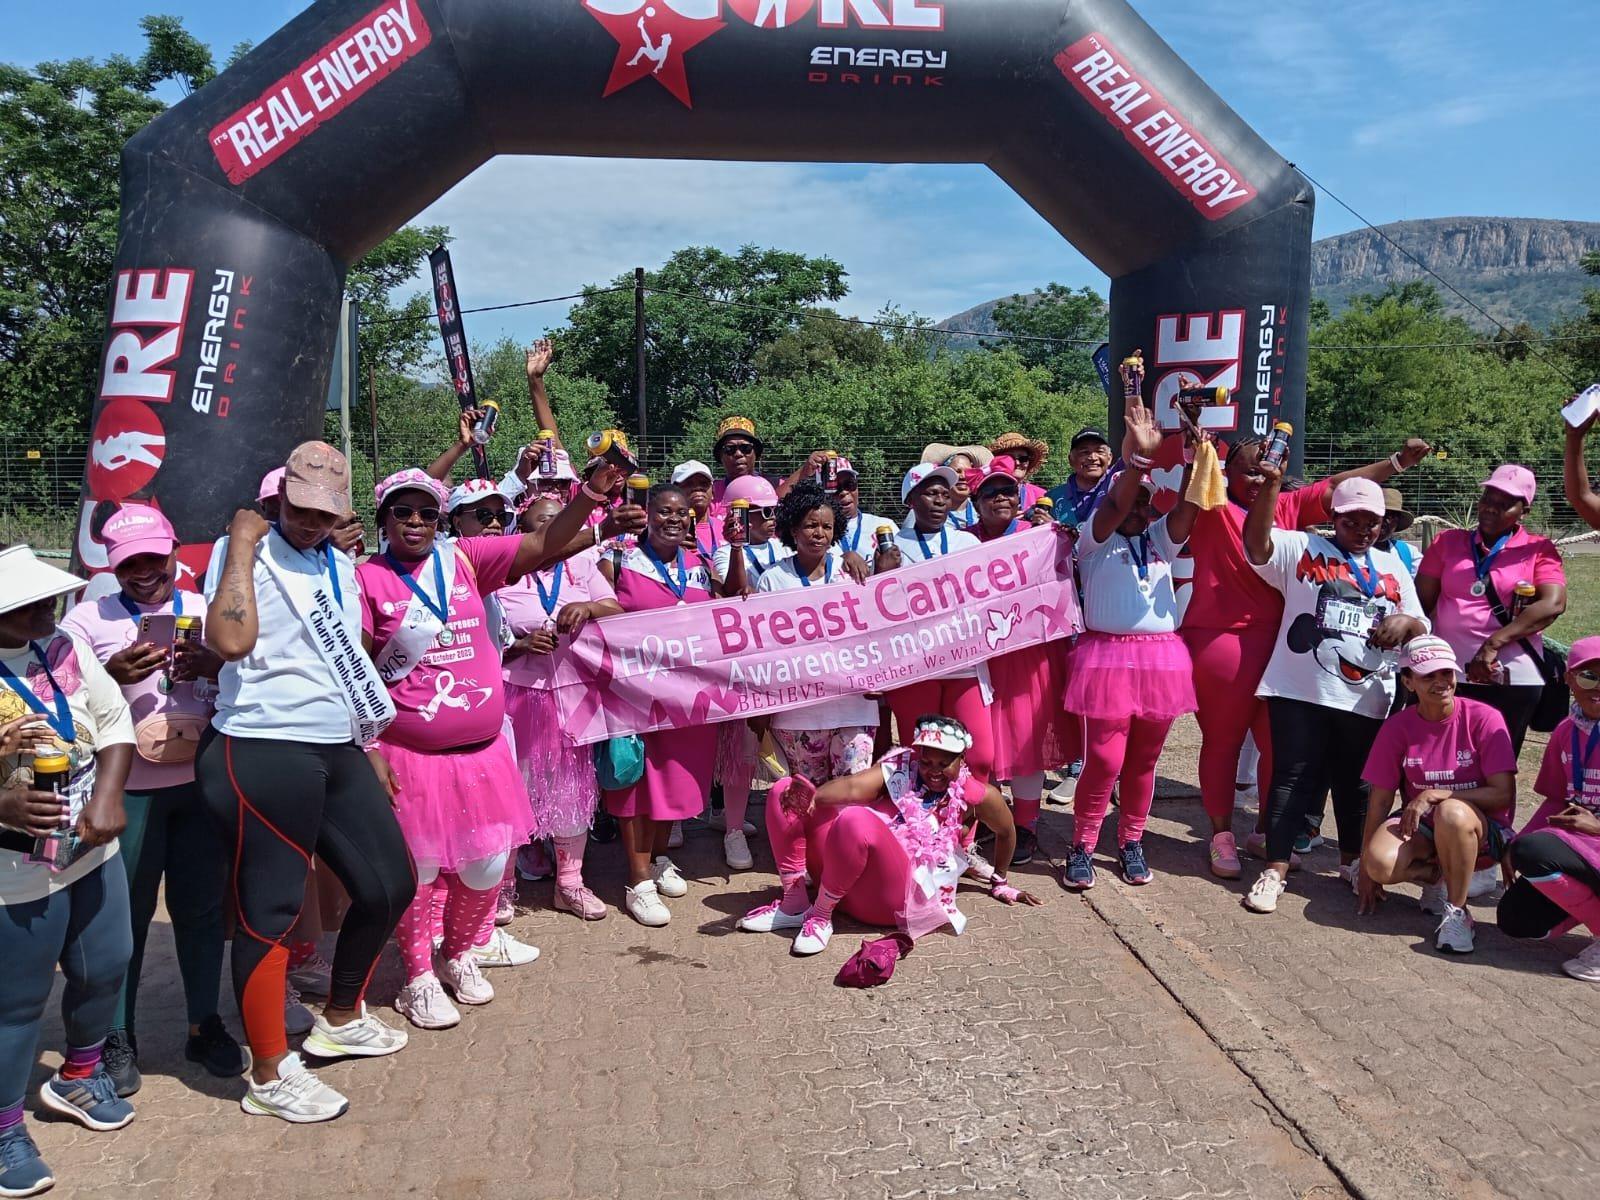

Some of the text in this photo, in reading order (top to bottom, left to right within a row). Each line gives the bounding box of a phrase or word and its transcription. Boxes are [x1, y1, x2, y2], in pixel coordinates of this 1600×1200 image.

[227, 86, 314, 167] REAL
[301, 0, 417, 112] ENERGY
[808, 72, 945, 86] DRINK
[810, 47, 947, 69] ENERGY
[1072, 49, 1152, 125] REAL
[1132, 109, 1249, 208] ENERGY
[191, 269, 234, 414] ENERGY
[216, 275, 253, 418] DRINK
[1252, 304, 1275, 436] ENERGY
[312, 588, 335, 620] Miss
[331, 618, 368, 682] Township
[361, 680, 388, 719] South
[619, 607, 983, 691] HOPE Awareness month
[711, 549, 1030, 655] Breast Cancer
[1338, 609, 1361, 628] 019
[309, 609, 337, 653] Charity
[332, 653, 369, 721] Ambassador
[738, 681, 826, 713] BELIEVE
[924, 654, 946, 669] We
[950, 641, 983, 662] Win!
